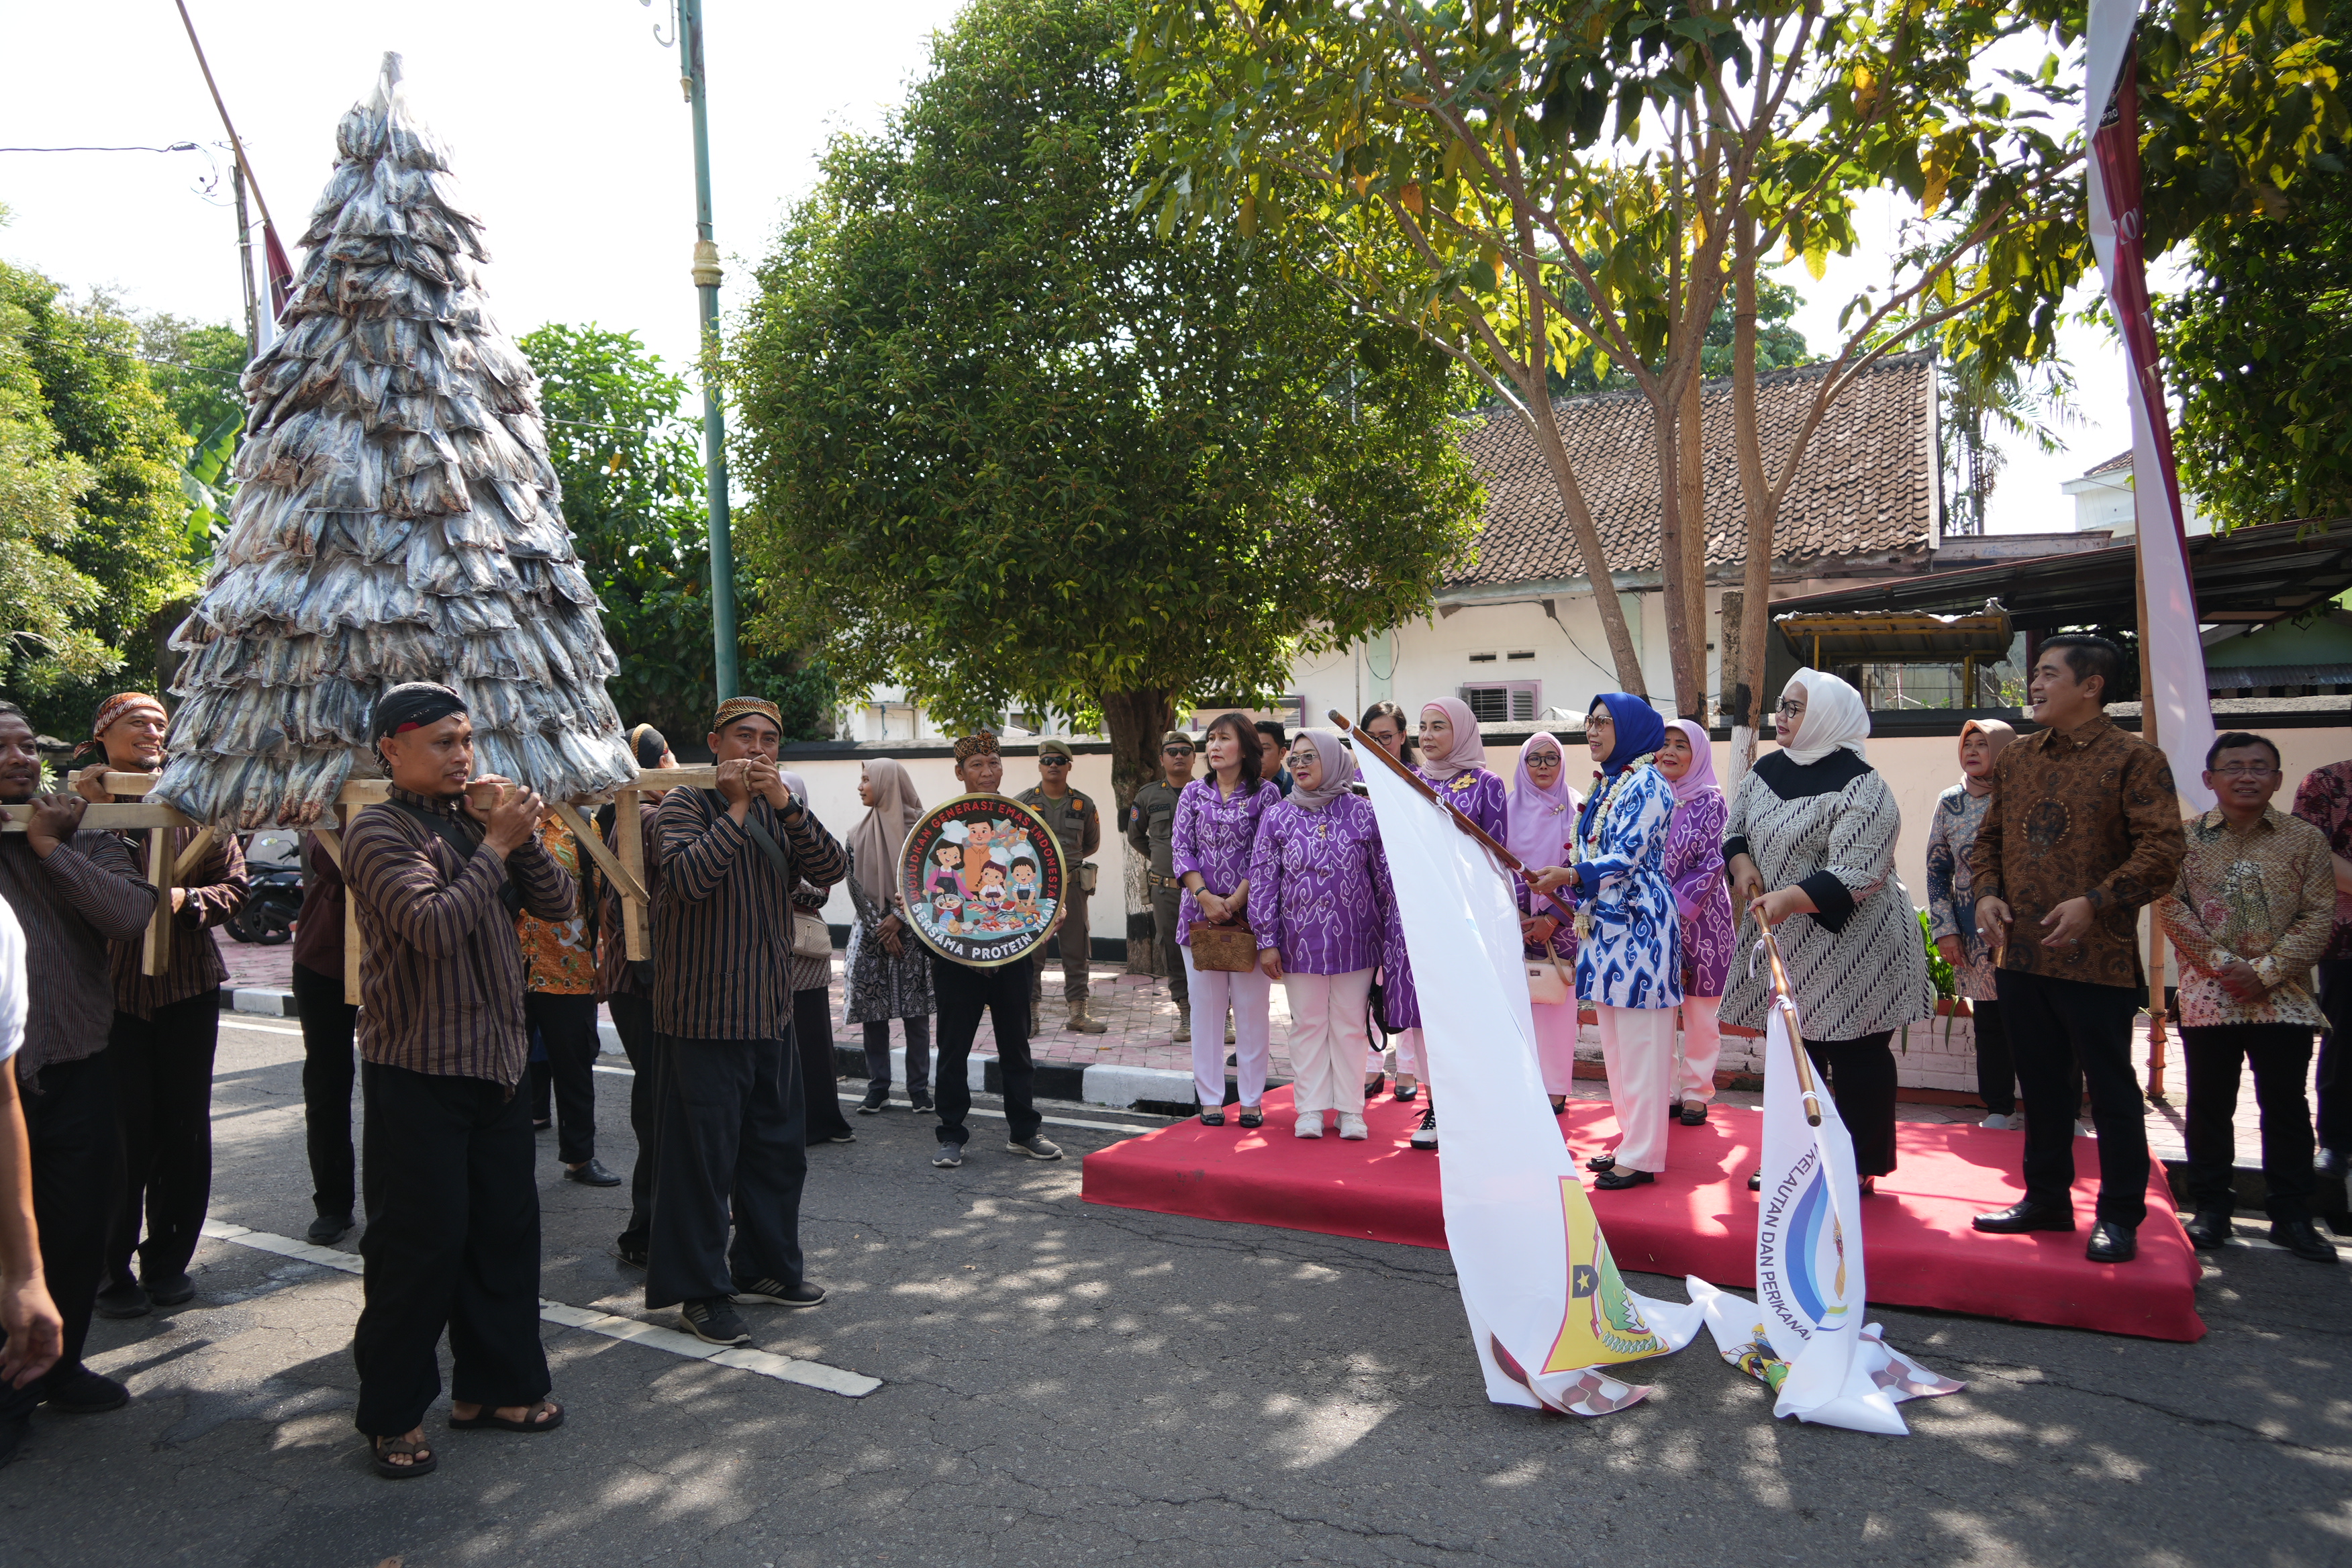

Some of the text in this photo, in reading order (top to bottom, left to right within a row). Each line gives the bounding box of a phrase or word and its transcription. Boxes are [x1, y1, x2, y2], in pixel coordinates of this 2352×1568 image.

[908, 801, 1058, 901] WUJUDKAN GENERASI EMAS INDONESIA
[911, 897, 1057, 959] BERSAMA PROTEIN IKAN
[1764, 1148, 1816, 1228] KELAUTAN
[1760, 1231, 1775, 1267] DAN
